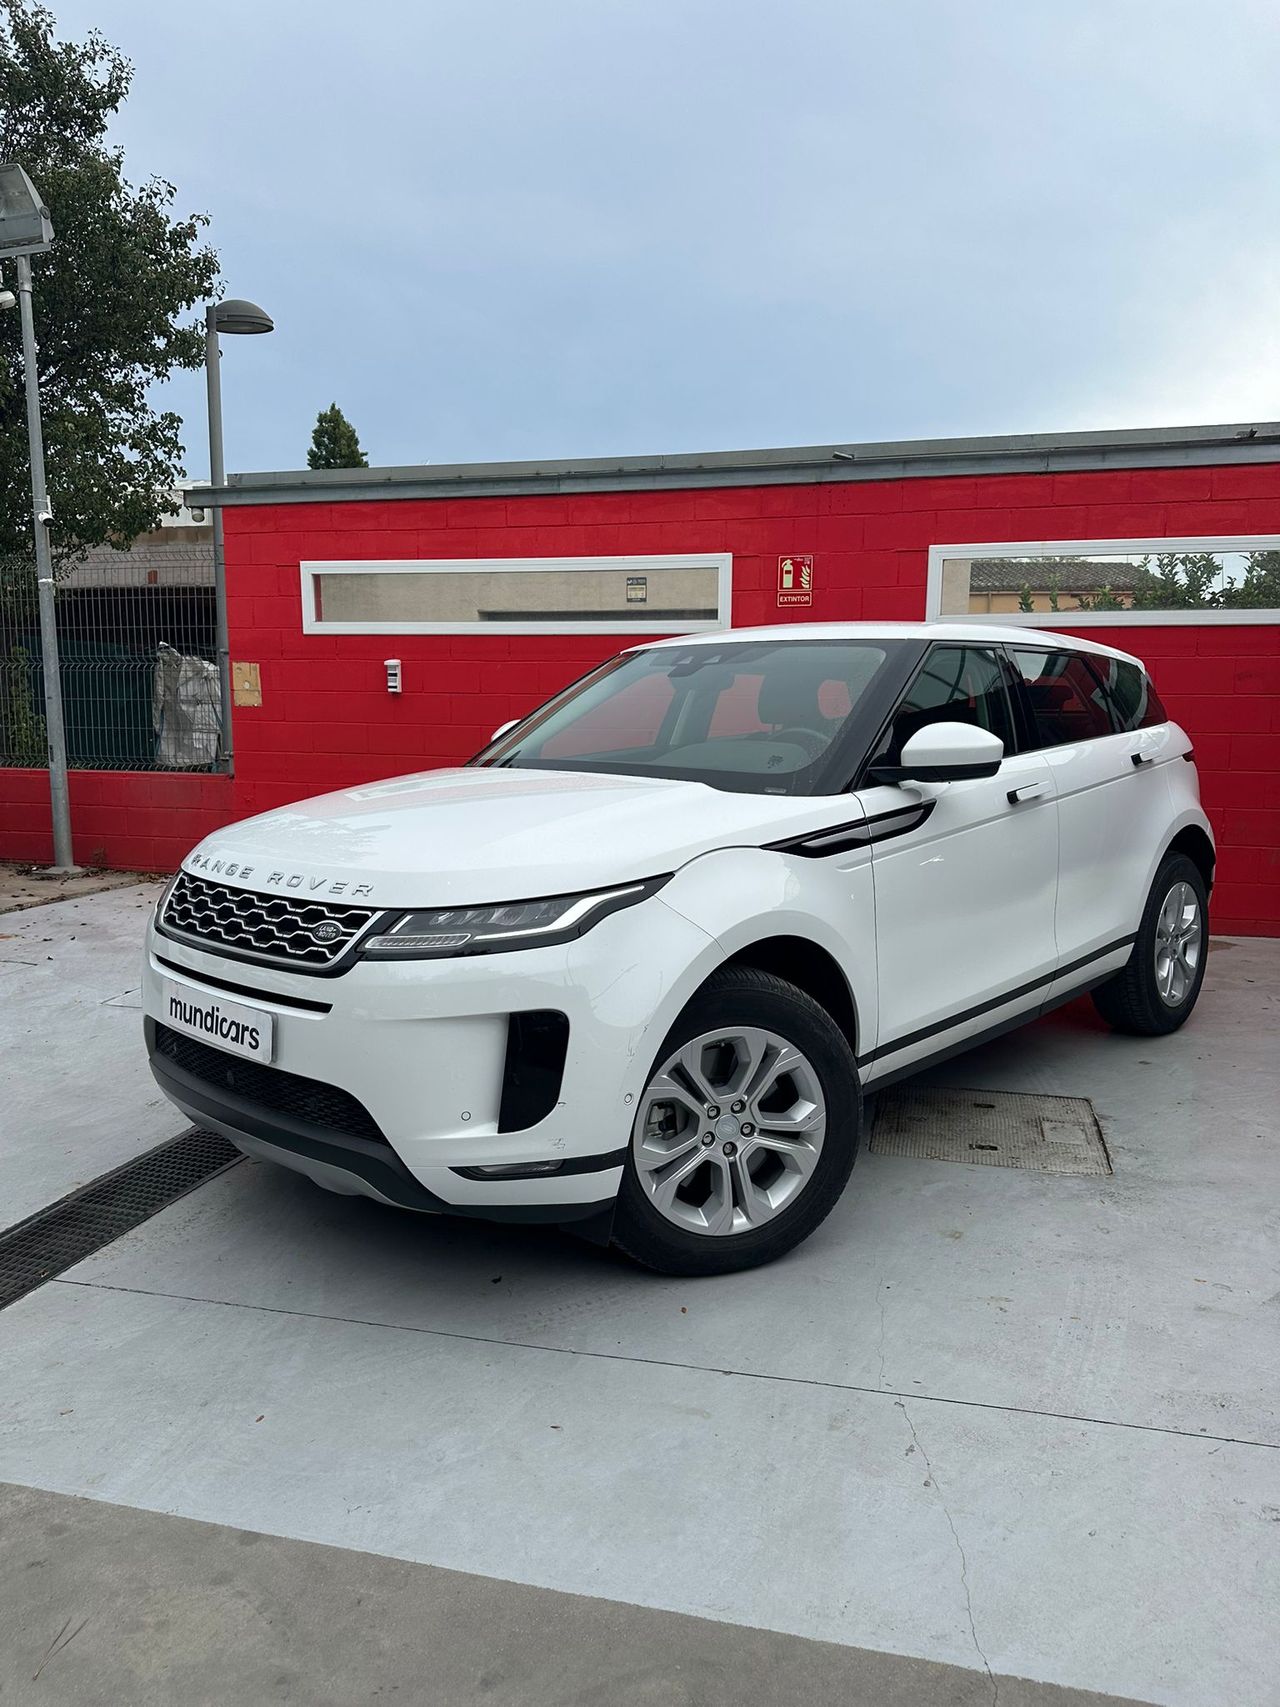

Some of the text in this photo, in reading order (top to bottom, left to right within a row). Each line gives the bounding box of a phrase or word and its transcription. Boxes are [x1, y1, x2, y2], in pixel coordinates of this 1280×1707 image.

[779, 595, 810, 603] EXTINTOR
[191, 853, 374, 897] RANGE ROVER
[170, 996, 260, 1050] mundicars
